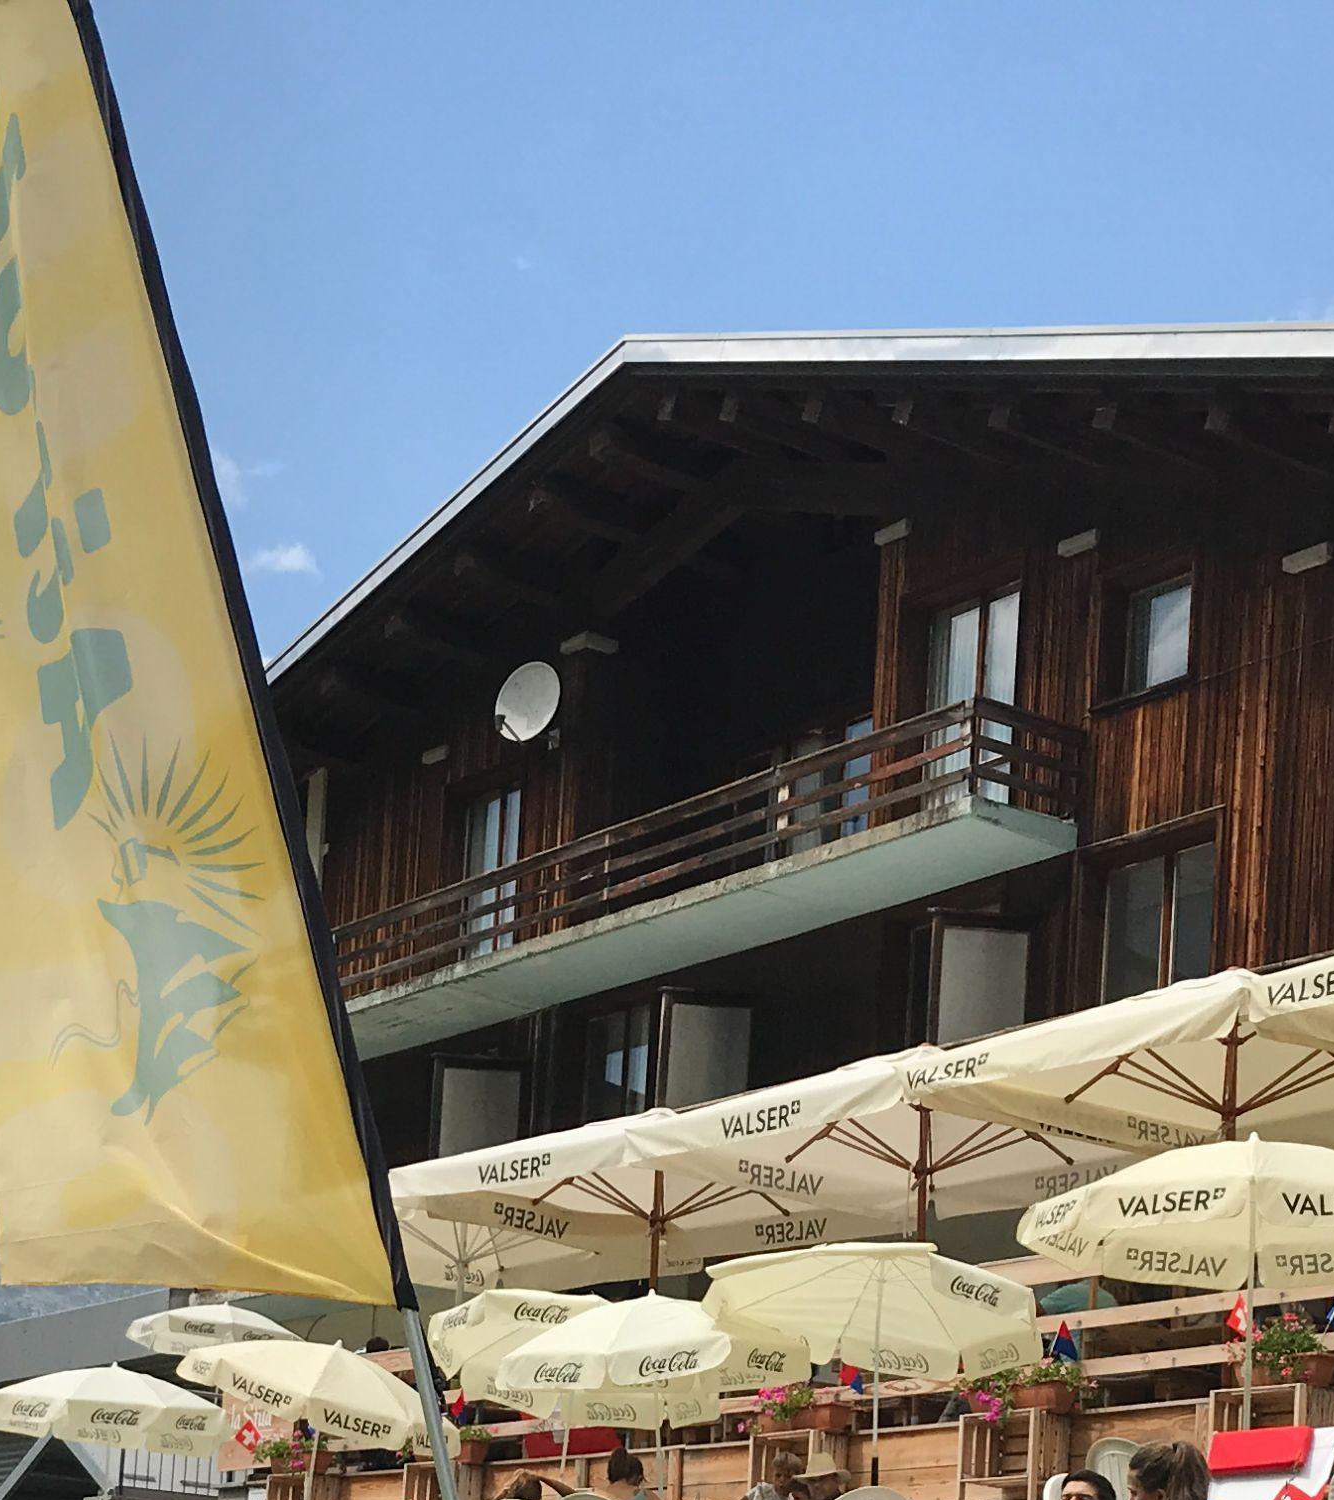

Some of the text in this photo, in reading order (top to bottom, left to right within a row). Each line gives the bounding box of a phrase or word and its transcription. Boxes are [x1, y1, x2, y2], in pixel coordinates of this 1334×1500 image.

[907, 1056, 977, 1090] VALSER
[721, 1104, 790, 1139] VALSER
[478, 1156, 541, 1185] VALSER
[1117, 1190, 1211, 1219] VALSER
[950, 1275, 1003, 1308] Coca-Cola
[514, 1301, 571, 1324] Coca-Cola
[533, 1362, 585, 1383] Coca-Cola
[639, 1350, 701, 1377] Coca-Cola
[747, 1347, 787, 1373] Coca-Cola
[232, 1372, 284, 1408] VALSER
[12, 1400, 50, 1418] Coca-Cola
[90, 1408, 142, 1427] Coca-Cola
[175, 1414, 208, 1432] Coca-Cola
[323, 1408, 383, 1438] VALSER
